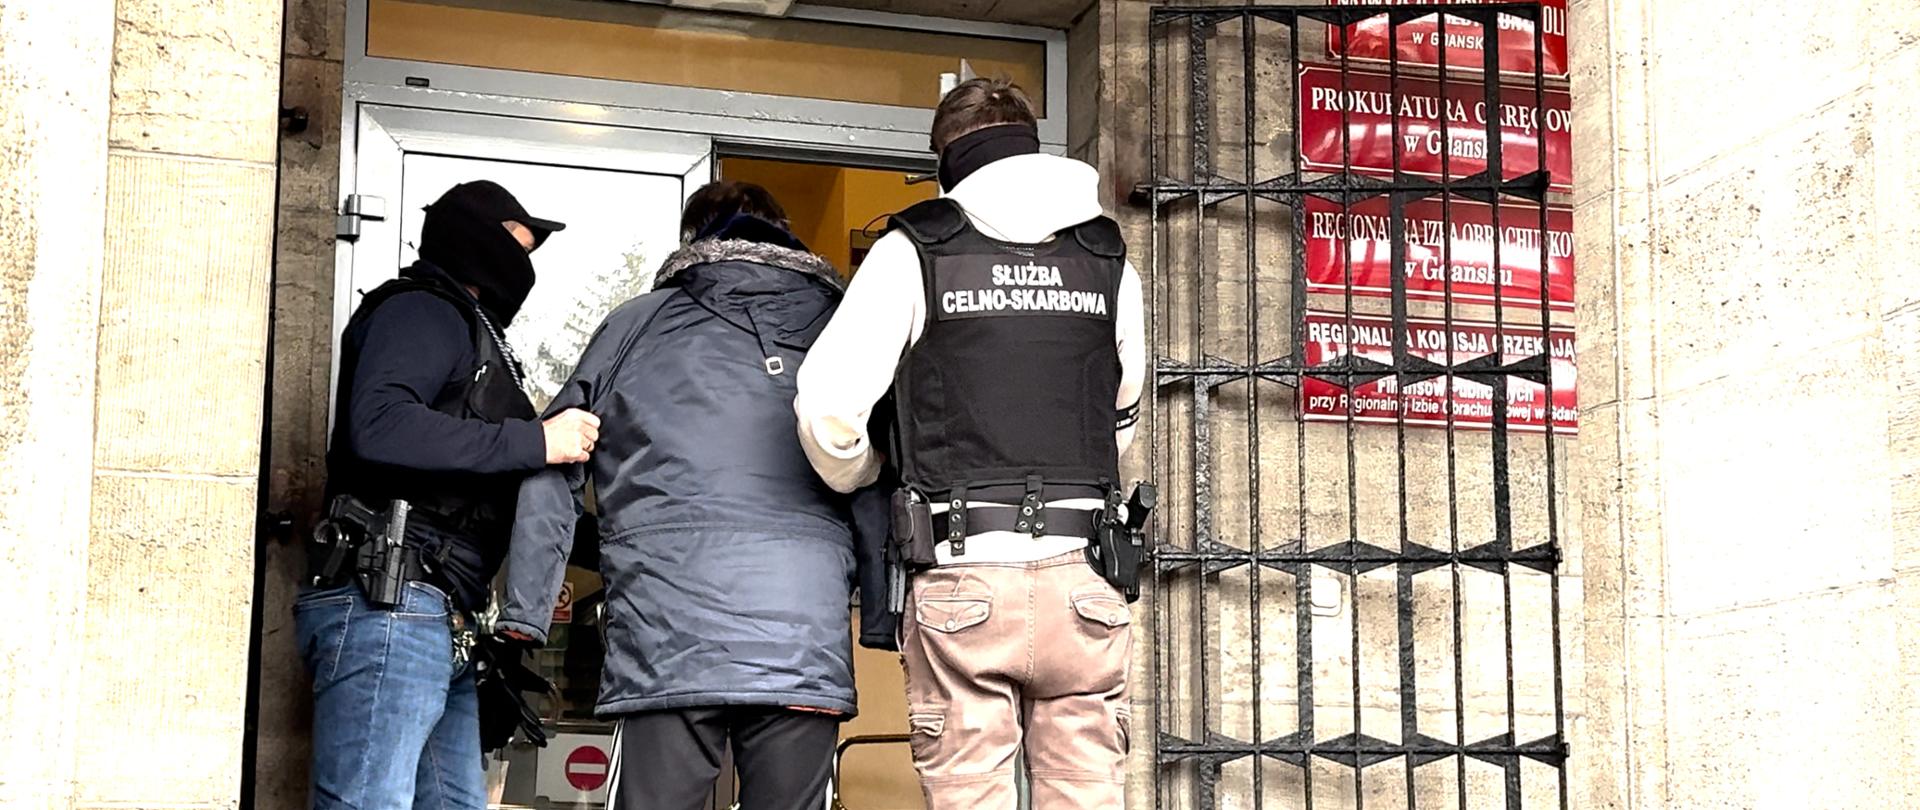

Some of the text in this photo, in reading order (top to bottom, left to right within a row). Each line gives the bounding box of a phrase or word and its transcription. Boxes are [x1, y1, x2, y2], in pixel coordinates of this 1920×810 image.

[1412, 31, 1485, 50] W GAŃSK
[1404, 130, 1503, 160] w Gańs
[1312, 211, 1420, 246] REGIONAA
[991, 261, 1063, 287] SŁUŻBA
[942, 289, 1107, 315] CELNO-SKARBOWA
[1308, 322, 1413, 348] REGIONALA
[1309, 396, 1336, 412] przy
[1340, 394, 1409, 416] Rgionalnj
[1411, 398, 1439, 413] Izbie
[1442, 399, 1532, 422] Obrachuowej
